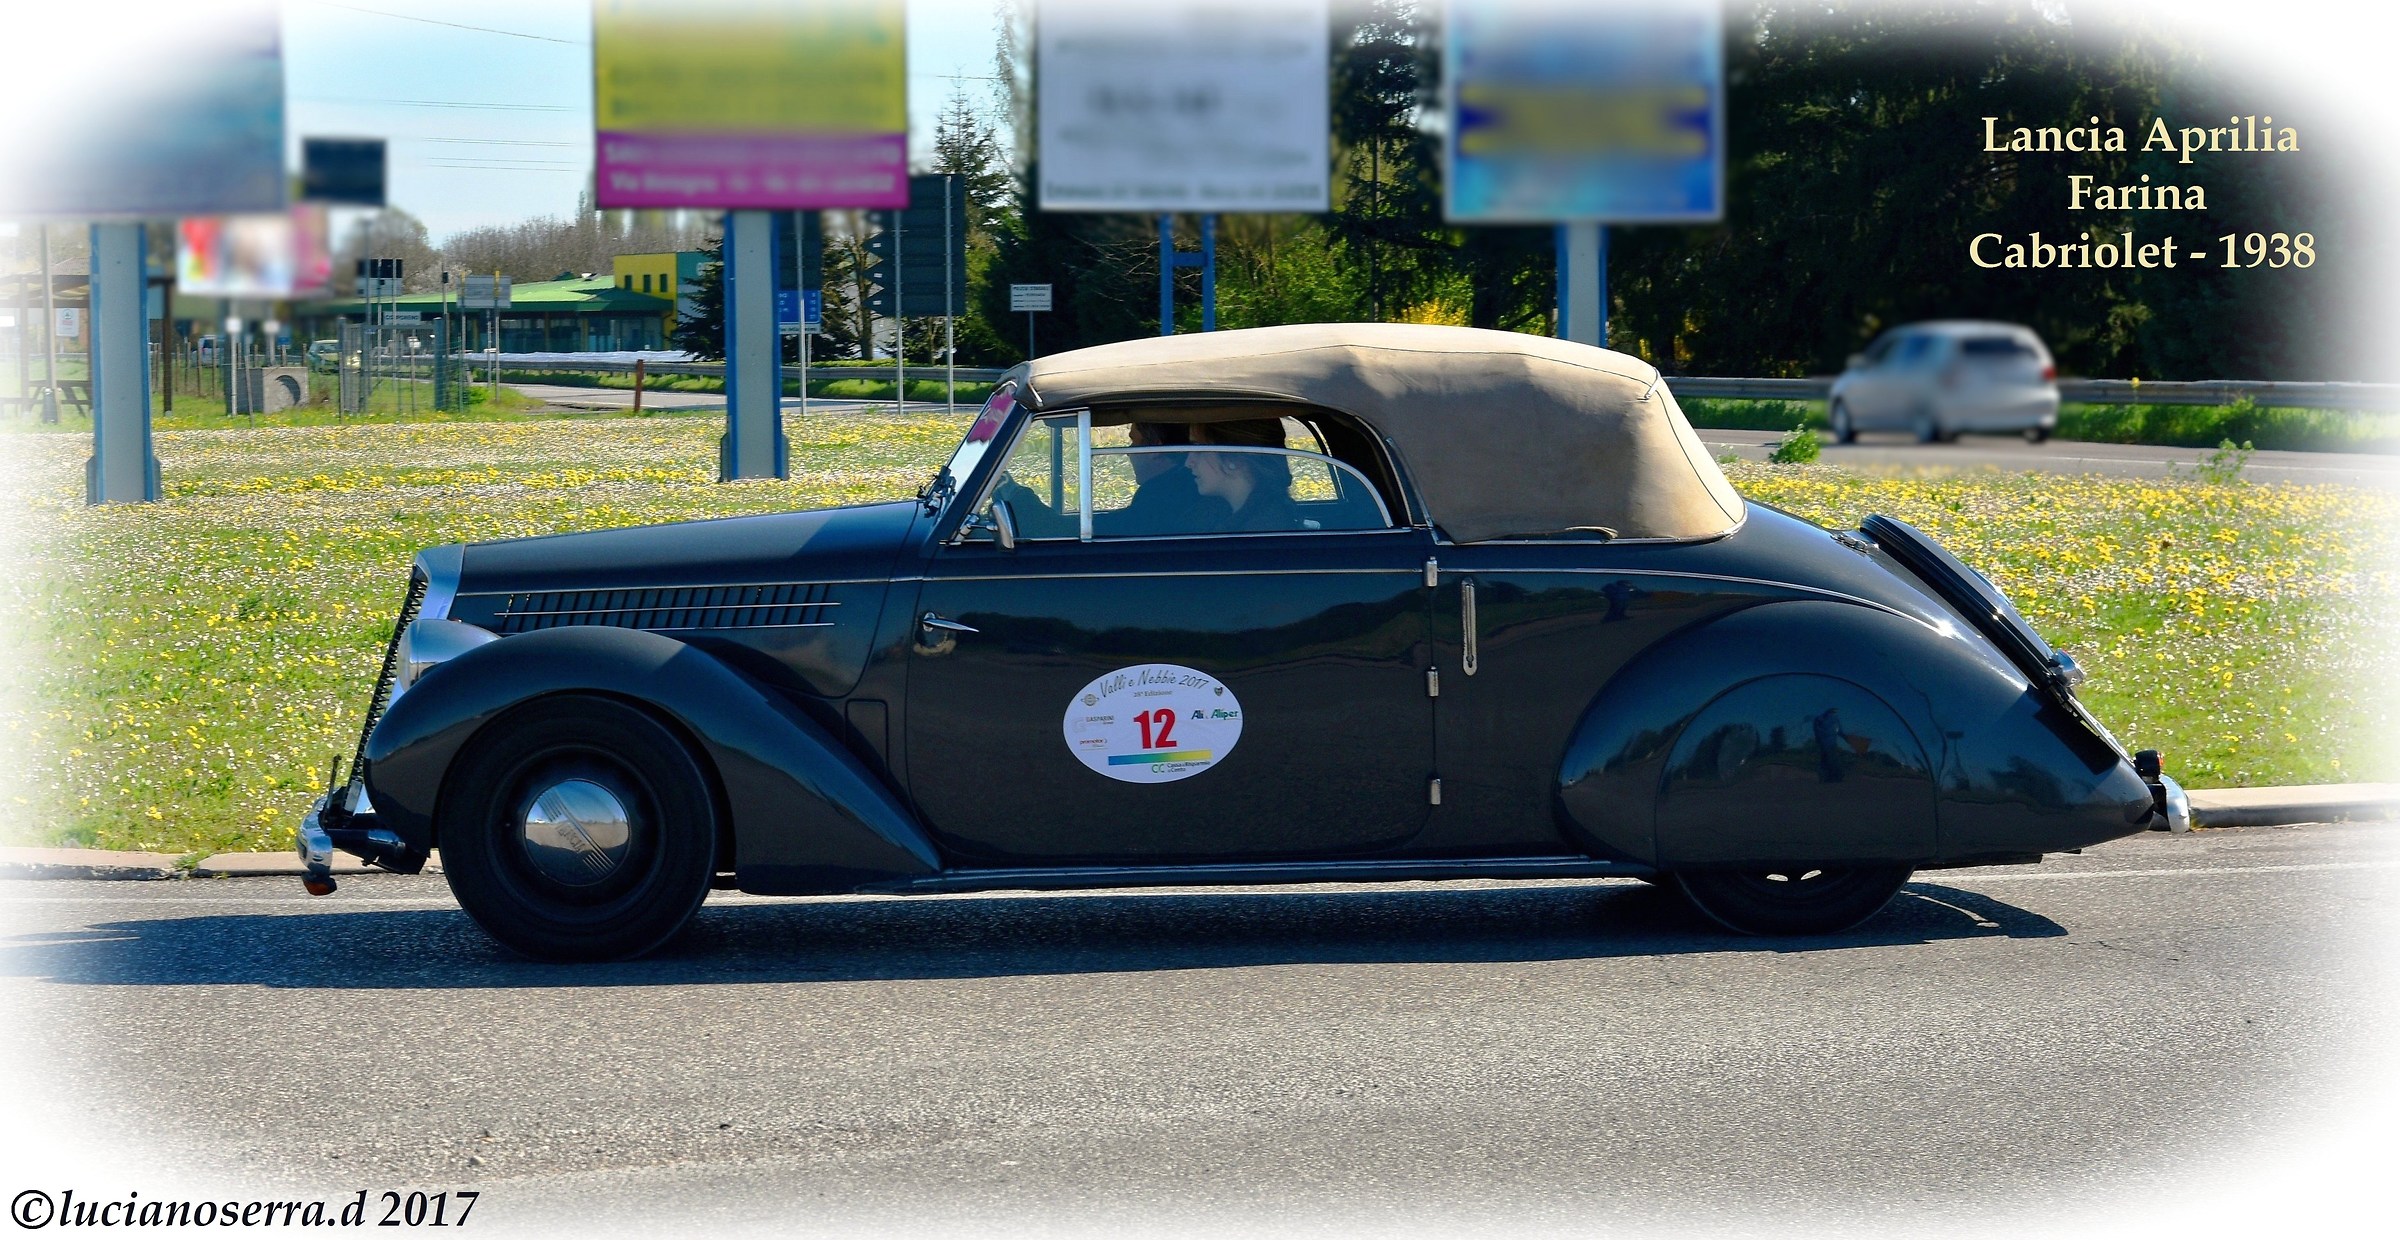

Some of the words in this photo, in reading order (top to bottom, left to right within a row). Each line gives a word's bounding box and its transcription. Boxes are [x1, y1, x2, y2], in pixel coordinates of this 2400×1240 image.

[1100, 674, 1127, 698] Valli
[1128, 679, 1136, 687] e
[1137, 668, 1177, 686] Nebbie
[1178, 674, 1209, 690] 2017
[1133, 708, 1177, 749] 12
